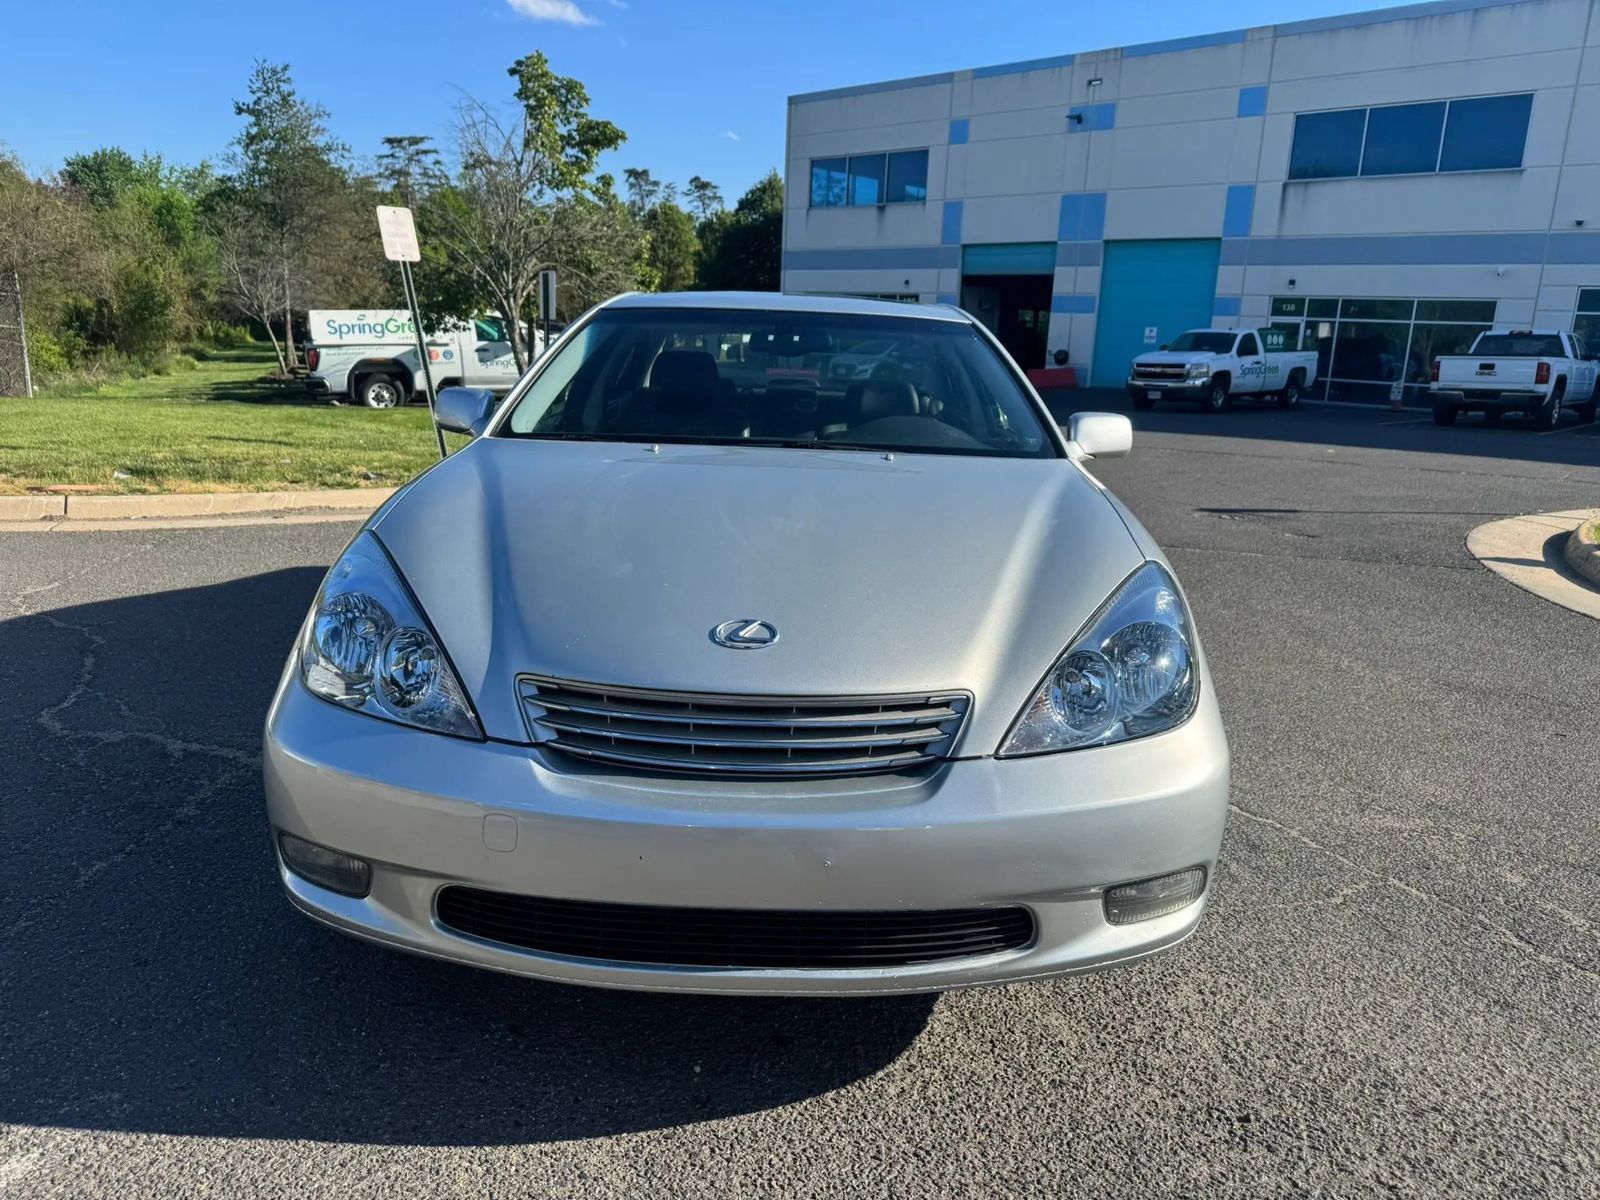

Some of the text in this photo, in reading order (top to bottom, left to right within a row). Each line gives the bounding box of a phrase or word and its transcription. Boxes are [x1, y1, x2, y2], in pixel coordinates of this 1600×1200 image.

[326, 318, 416, 340] SpringGre
[480, 357, 516, 369] SpringG
[1240, 363, 1280, 378] SpringGreen
